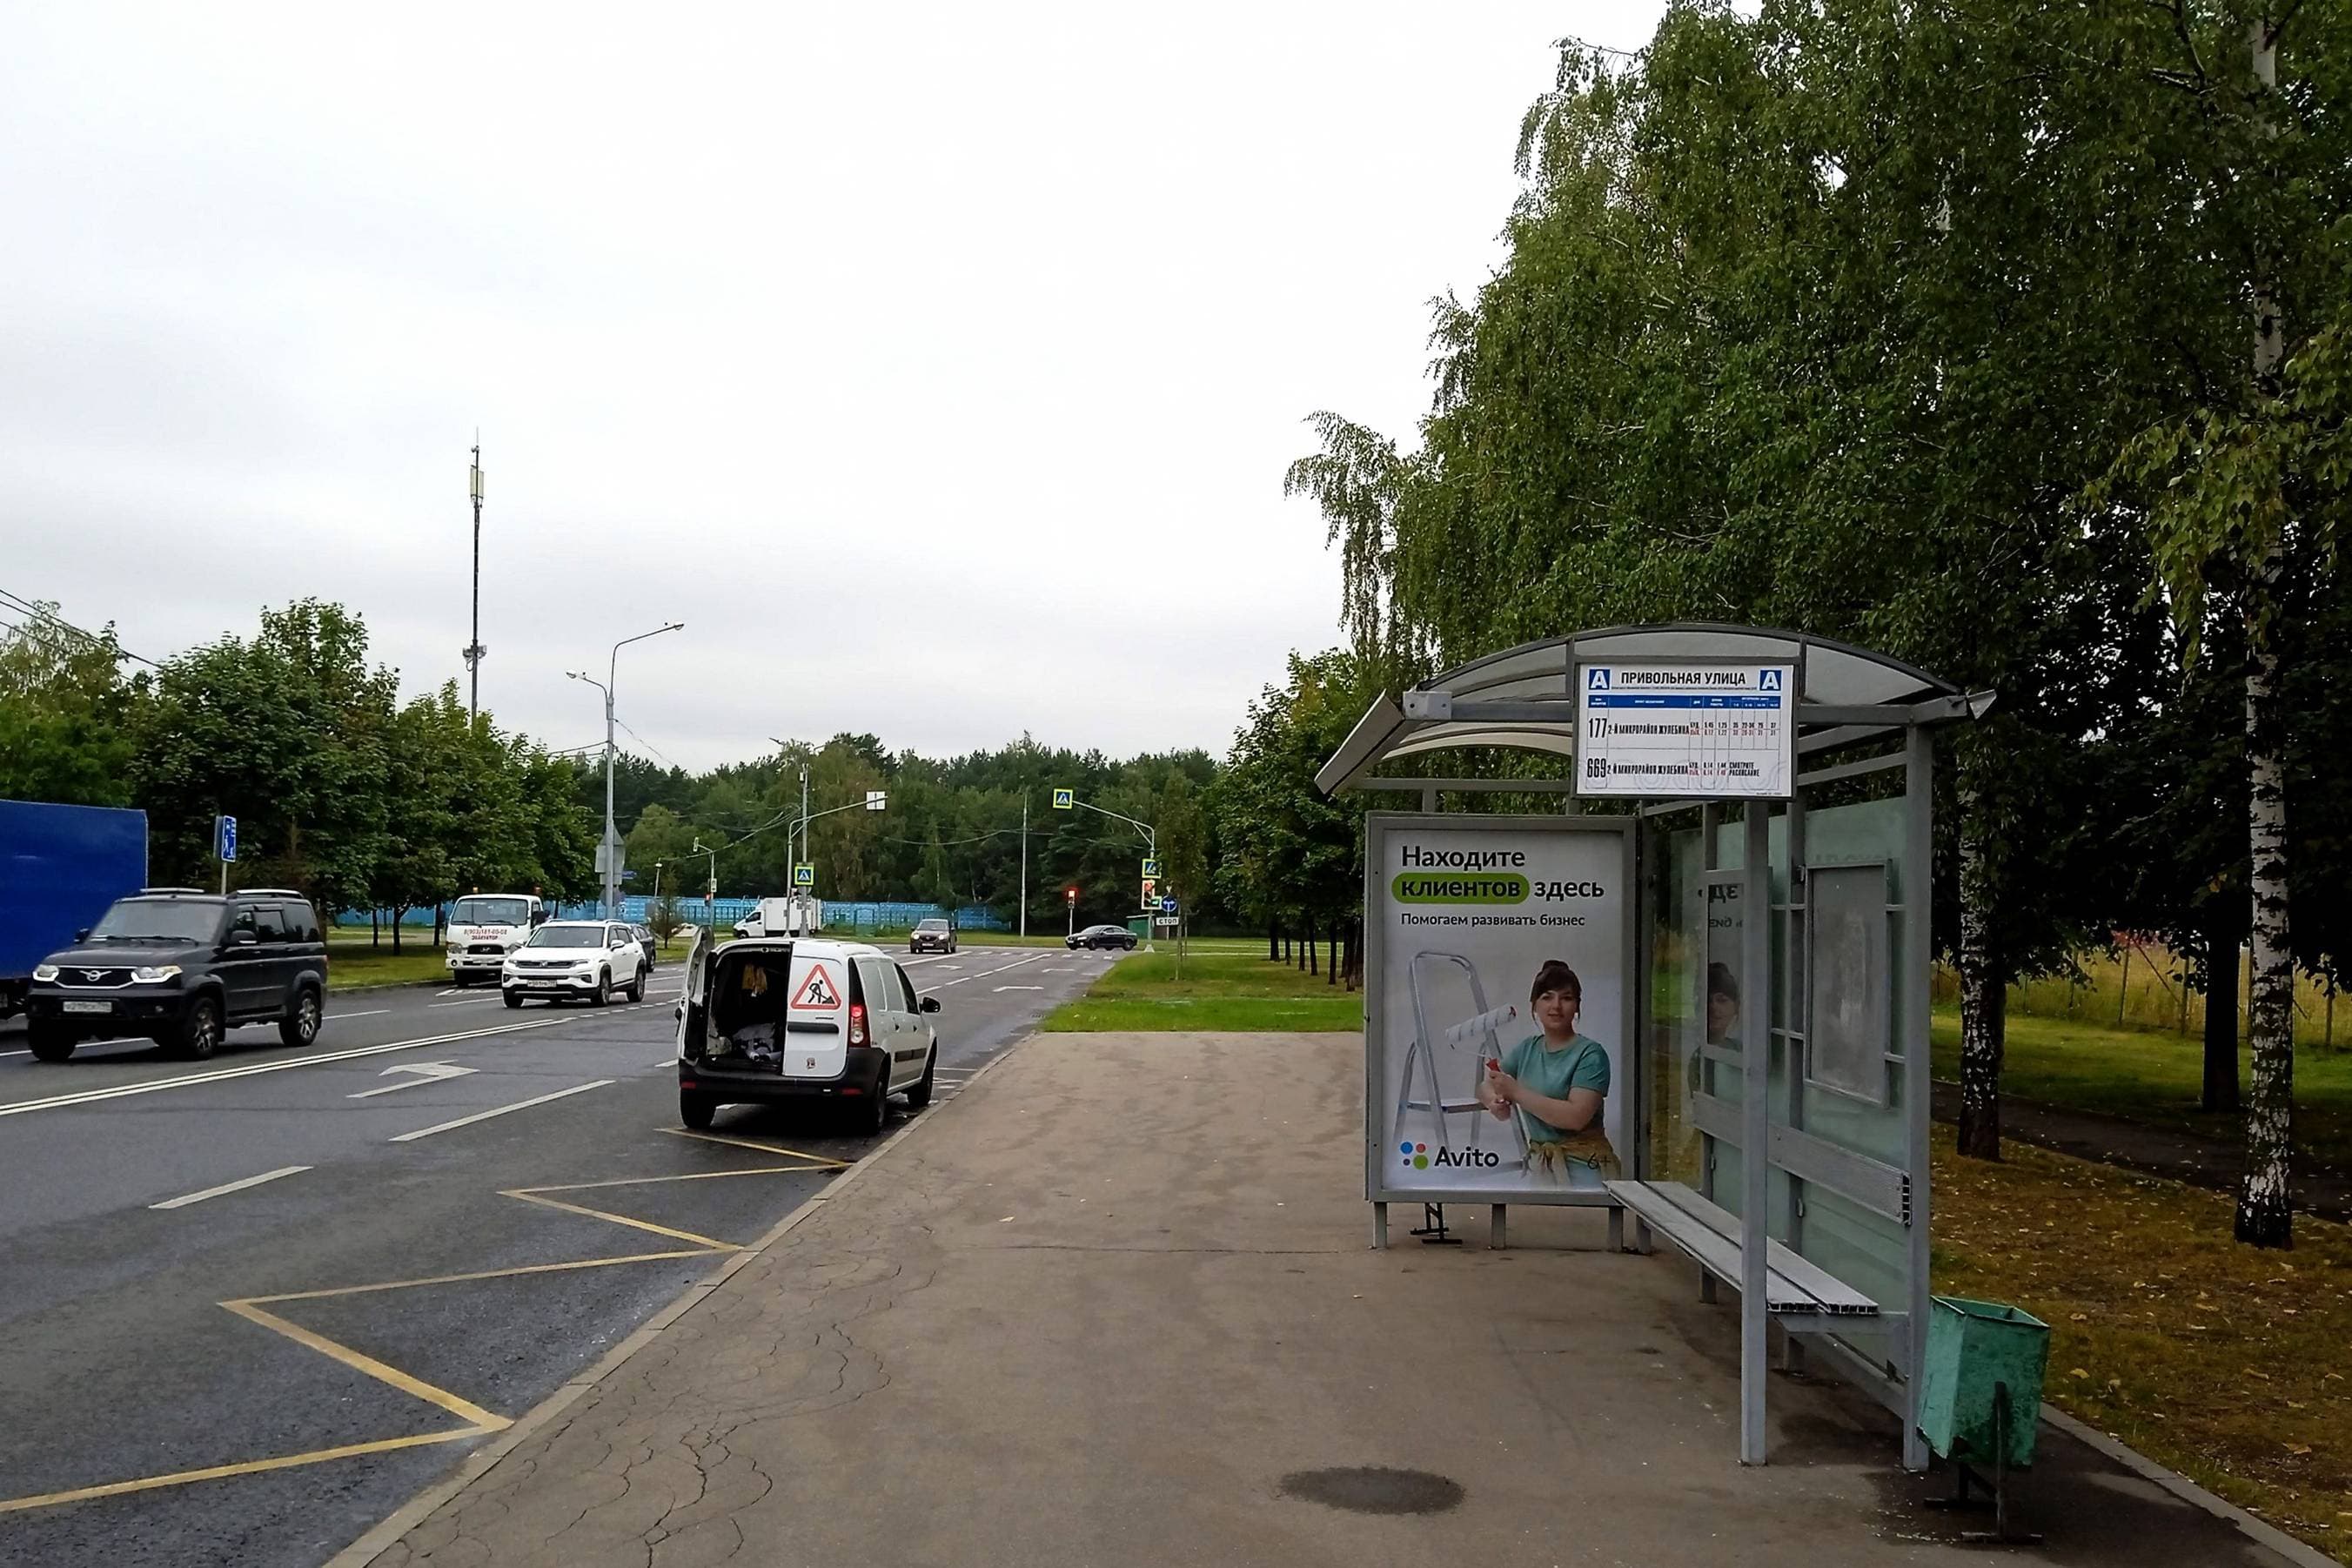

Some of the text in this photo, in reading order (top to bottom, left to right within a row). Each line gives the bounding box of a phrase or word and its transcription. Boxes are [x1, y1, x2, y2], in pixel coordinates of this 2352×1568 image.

[1591, 671, 1608, 688] А
[1621, 672, 1746, 686] ПРИВОЛЬНАЯ УЛИЦА
[1761, 672, 1779, 690] А
[1589, 718, 1607, 738] 177
[1619, 723, 1658, 734] МИКРОРАЙОН
[1658, 725, 1689, 734] ЖУЛЕБИНА
[1587, 758, 1607, 778] 669
[1618, 763, 1656, 774] МИКРОРАЙОН
[1658, 765, 1688, 774] ЖУЛЕБИНА
[1402, 846, 1525, 872] Находите
[1402, 881, 1605, 901] клиентов здесь
[1401, 914, 1586, 927] Помогаем развивать бизнес
[1434, 1146, 1499, 1167] Avito
[1588, 1152, 1612, 1169] 6+
